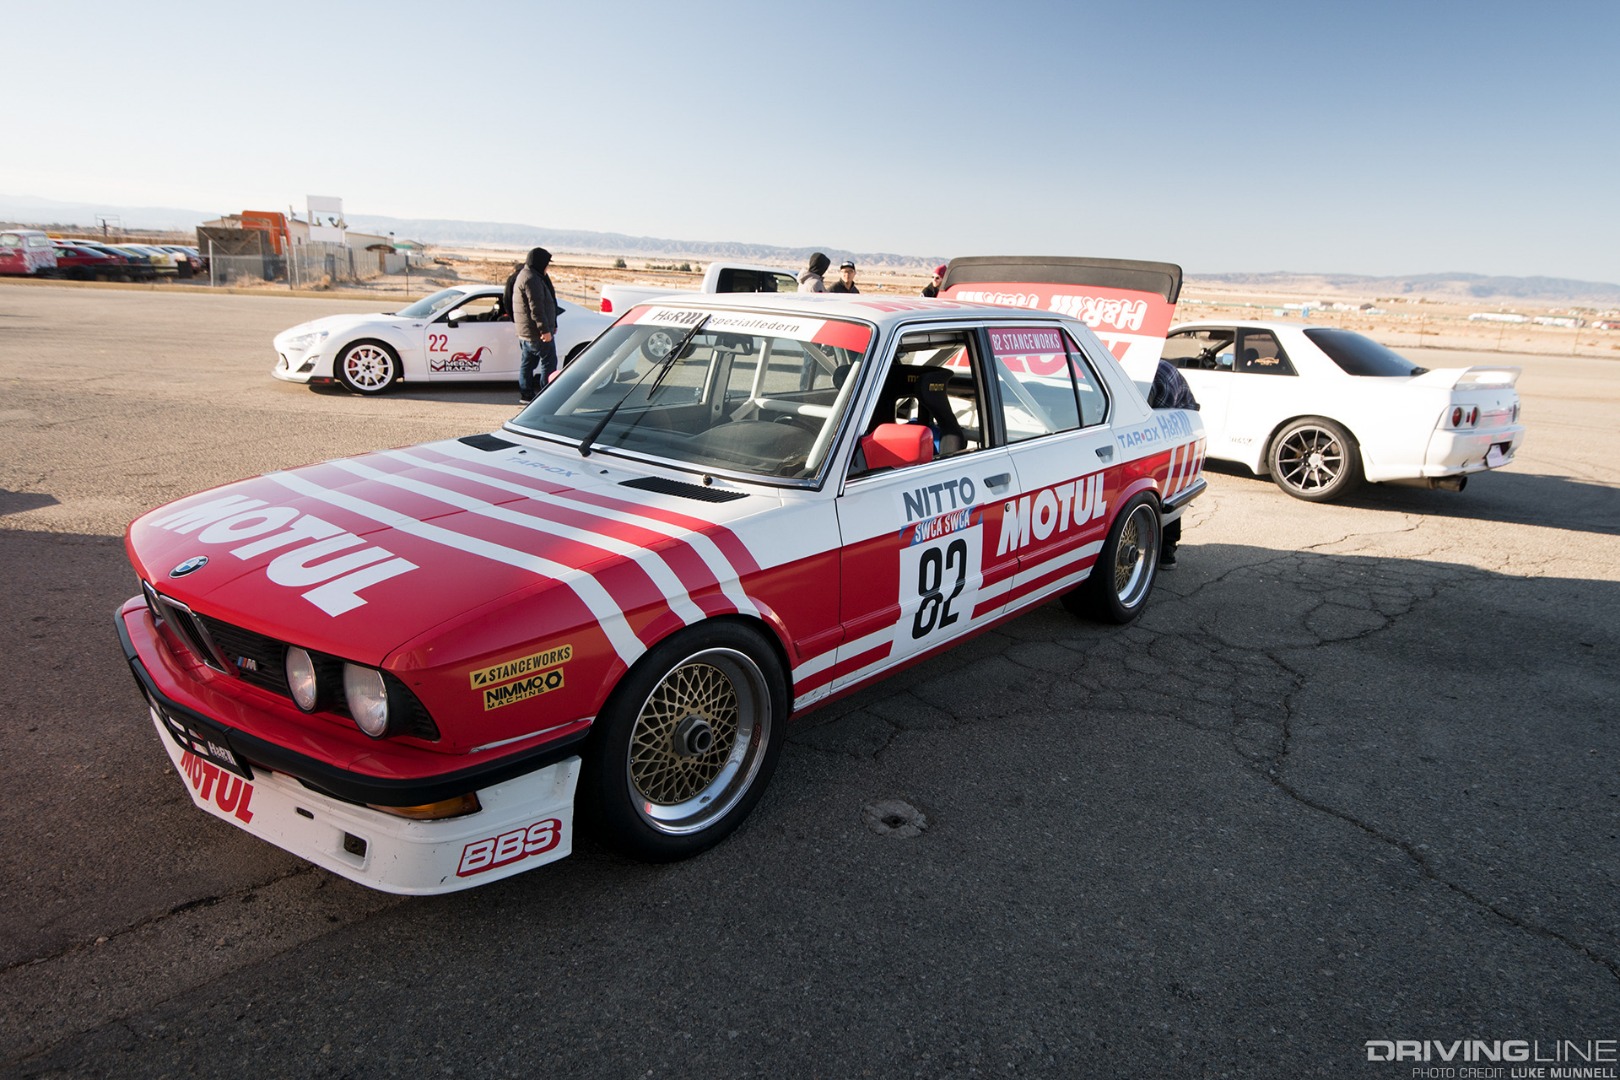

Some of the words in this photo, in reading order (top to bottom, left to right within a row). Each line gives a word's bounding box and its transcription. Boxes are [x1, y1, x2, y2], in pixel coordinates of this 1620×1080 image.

[428, 333, 449, 352] 22
[709, 317, 800, 333] spezialfedern
[992, 334, 1003, 351] 82
[1003, 333, 1061, 350] STANCEWORKS
[902, 476, 976, 522] NITTO
[996, 472, 1107, 557] MOTUL
[915, 517, 943, 543] SWCA
[945, 511, 970, 534] SWCA
[149, 494, 420, 618] MOTUL
[911, 538, 968, 640] 82
[488, 646, 571, 682] STANCEWORKS
[486, 676, 544, 704] NIMMO
[487, 687, 545, 710] MACHINE
[180, 750, 254, 824] MOTUL
[456, 818, 562, 877] BBS
